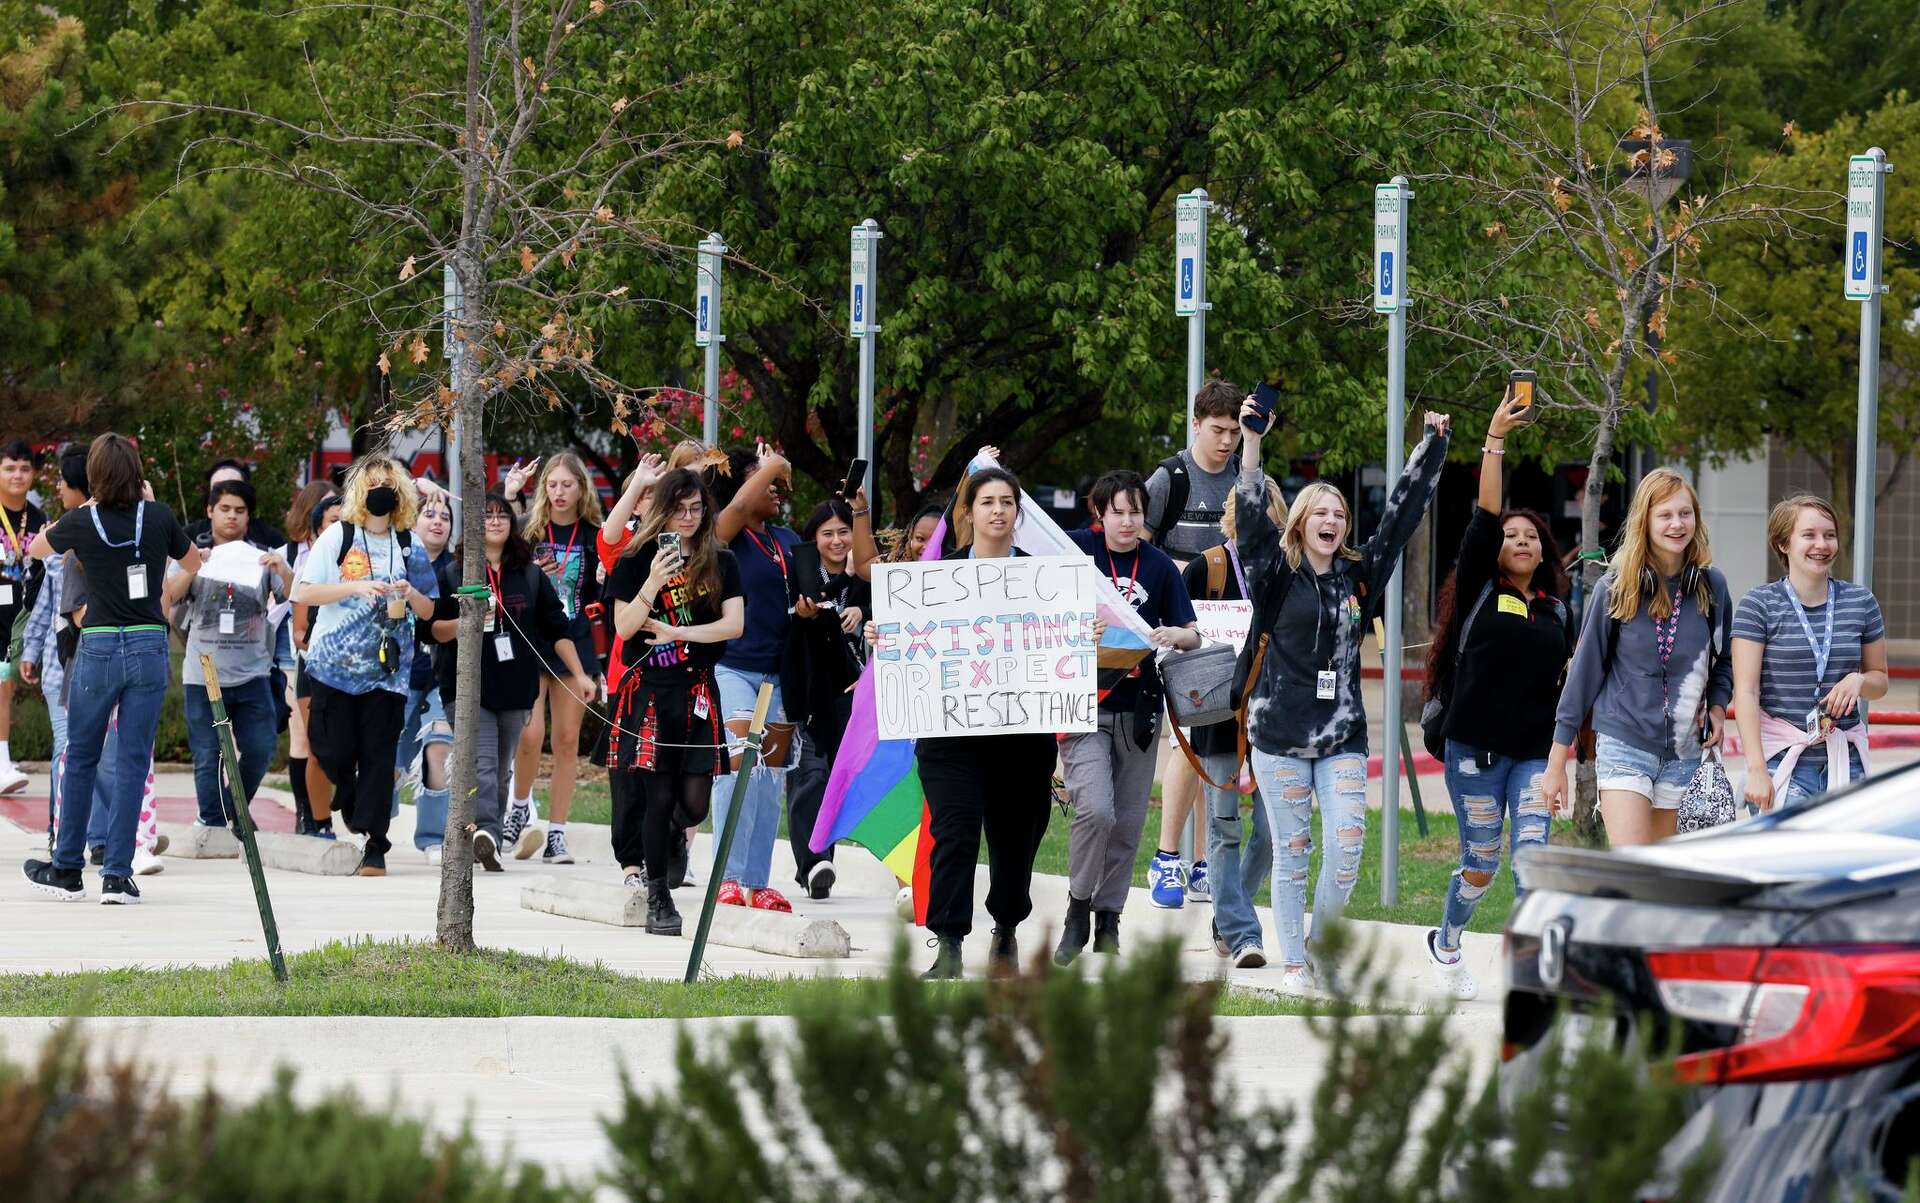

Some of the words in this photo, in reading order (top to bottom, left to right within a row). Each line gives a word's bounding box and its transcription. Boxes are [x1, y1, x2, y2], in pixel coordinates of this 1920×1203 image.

[1850, 171, 1873, 188] RESERVED
[1178, 207, 1198, 222] RESERVED
[1377, 197, 1398, 213] RESERVED
[1850, 201, 1872, 218] PARKING
[1377, 224, 1397, 240] PARKING
[887, 563, 1089, 610] RESPECT
[876, 611, 1096, 661] EXISTANCE
[649, 646, 689, 667] LOVE
[880, 662, 933, 736] OR
[940, 651, 1096, 691] EXPECT
[942, 691, 1096, 732] RESISTANCE
